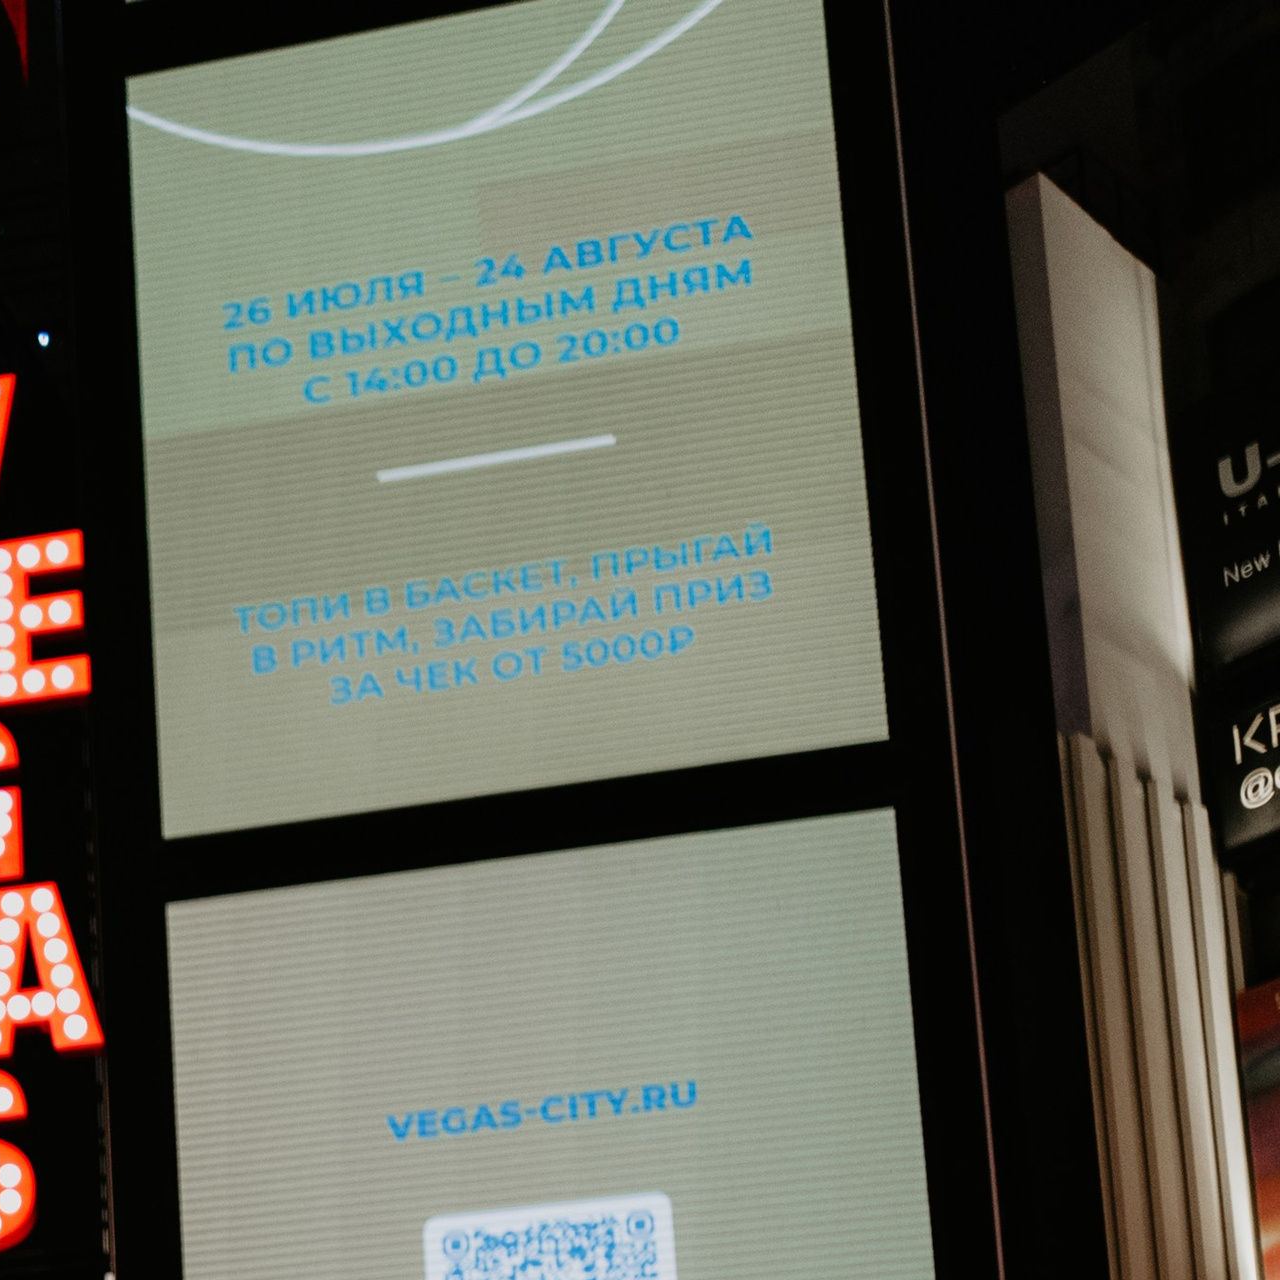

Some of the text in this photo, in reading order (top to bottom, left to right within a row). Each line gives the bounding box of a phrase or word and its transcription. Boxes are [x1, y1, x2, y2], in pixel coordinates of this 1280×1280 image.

[223, 296, 273, 332] 26
[285, 269, 425, 320] ИЮЛЯ
[474, 253, 527, 288] 24
[542, 214, 754, 276] АВГУСТА
[227, 257, 753, 374] ПО ВЫХОДНЫМ ДНЯМ
[302, 315, 681, 405] С 14:00 ДО 20:00
[1223, 486, 1280, 526] ITA
[235, 523, 773, 634] ТОПИ В БАСКЕТ, ПРЫГАЙ
[1223, 551, 1271, 588] New
[252, 570, 773, 675] В РИТМ, ЗАБИРАЙ ПРИЗ
[331, 672, 384, 705] ЗА
[395, 658, 478, 692] ЧЕК
[491, 646, 547, 681] ОТ
[386, 1079, 698, 1142] VEGAS-CITY.RU
